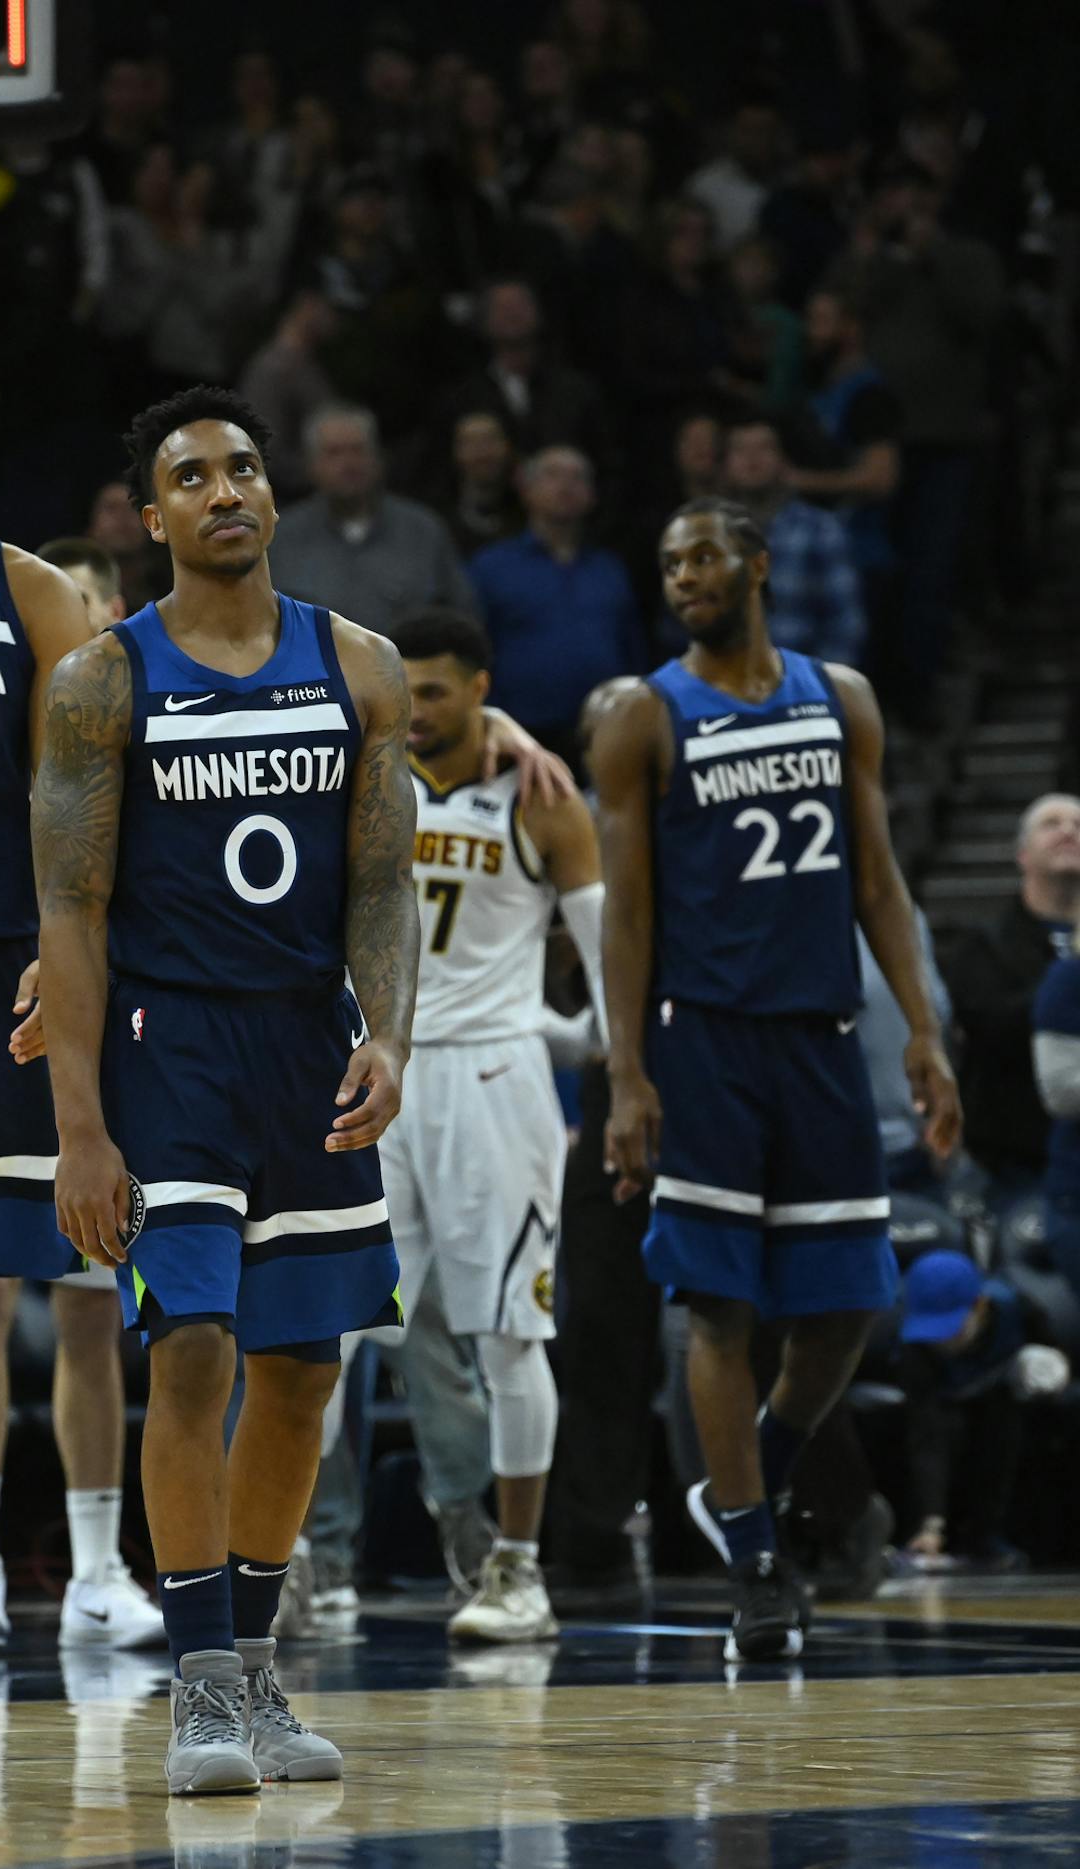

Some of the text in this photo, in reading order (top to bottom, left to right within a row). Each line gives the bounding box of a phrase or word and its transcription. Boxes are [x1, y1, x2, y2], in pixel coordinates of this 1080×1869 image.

[286, 686, 328, 703] fitbit
[152, 746, 346, 801] MINNESOTA
[690, 748, 842, 807] MINNESOTA
[224, 813, 297, 905] 0
[415, 832, 505, 876] GETS
[732, 799, 841, 882] 22
[416, 878, 464, 958] 7
